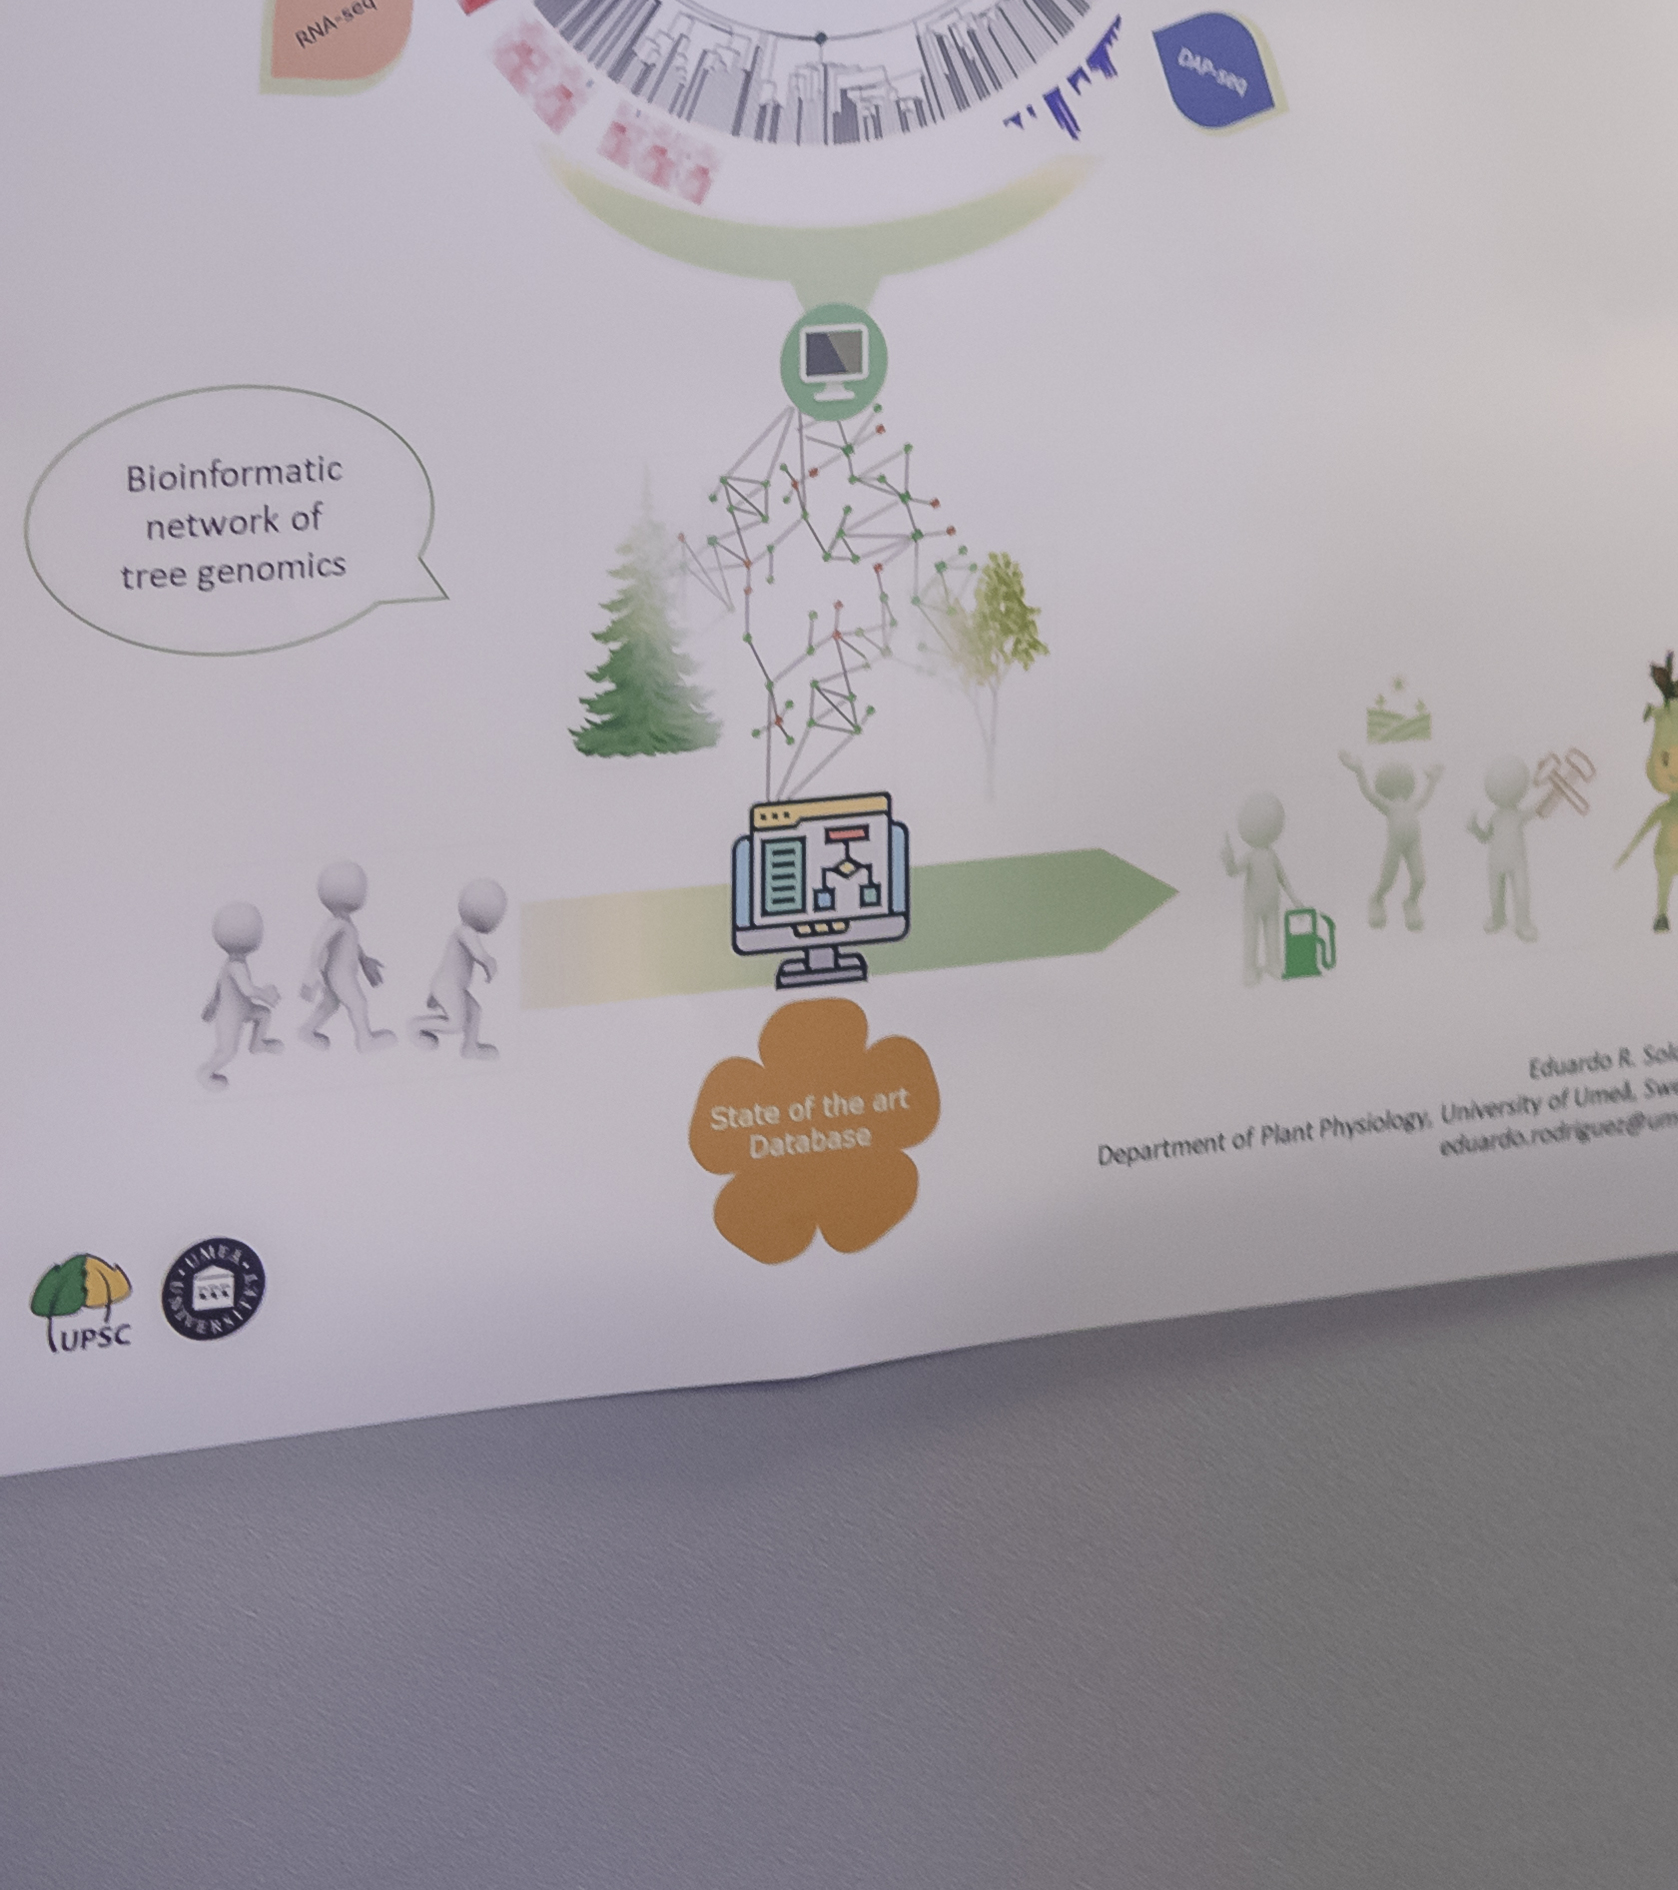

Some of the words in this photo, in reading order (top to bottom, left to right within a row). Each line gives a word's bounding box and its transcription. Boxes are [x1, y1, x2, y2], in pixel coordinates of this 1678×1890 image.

[128, 456, 341, 492] Bioinformatic
[147, 505, 279, 540] network
[292, 501, 323, 531] of
[121, 567, 186, 589] tree
[197, 552, 346, 592] genomics
[1529, 1051, 1613, 1080] Eduardo
[1618, 1048, 1635, 1068] R.
[711, 1104, 779, 1130] State
[789, 1095, 815, 1121] of
[823, 1092, 864, 1118] the
[873, 1088, 909, 1112] art
[1098, 1133, 1225, 1167] Department
[1232, 1126, 1254, 1150] of
[1261, 1122, 1313, 1146] Plant
[1320, 1110, 1432, 1140] Physiology,
[1441, 1096, 1542, 1124] University
[1548, 1088, 1569, 1111] of
[750, 1128, 871, 1159] Database
[61, 1324, 130, 1351] UPSC
